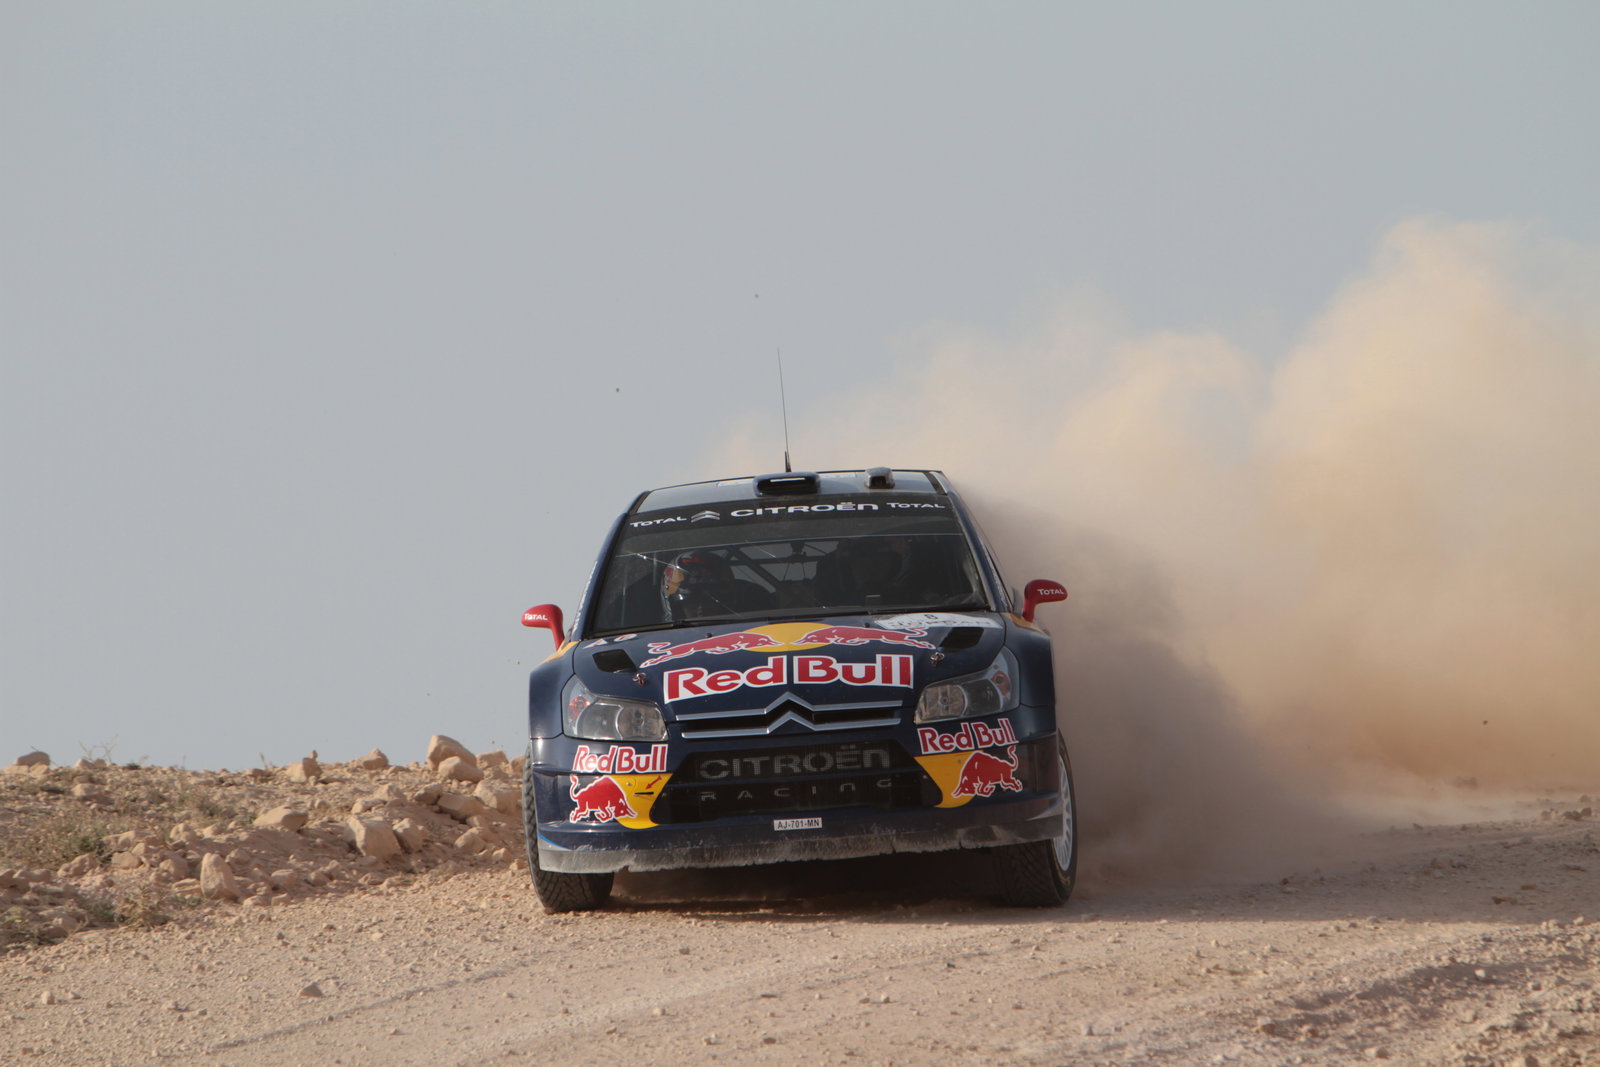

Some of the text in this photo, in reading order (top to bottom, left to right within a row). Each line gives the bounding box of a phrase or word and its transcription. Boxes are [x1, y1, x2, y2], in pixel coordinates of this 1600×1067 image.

[630, 515, 687, 528] TOTAL
[886, 501, 946, 510] TOTAL
[1037, 588, 1065, 596] TOTAL
[665, 655, 912, 702] Red Bull
[918, 719, 1017, 753] Red Bull
[573, 745, 667, 772] Red Bull
[777, 818, 820, 830] AJ-701-MN
